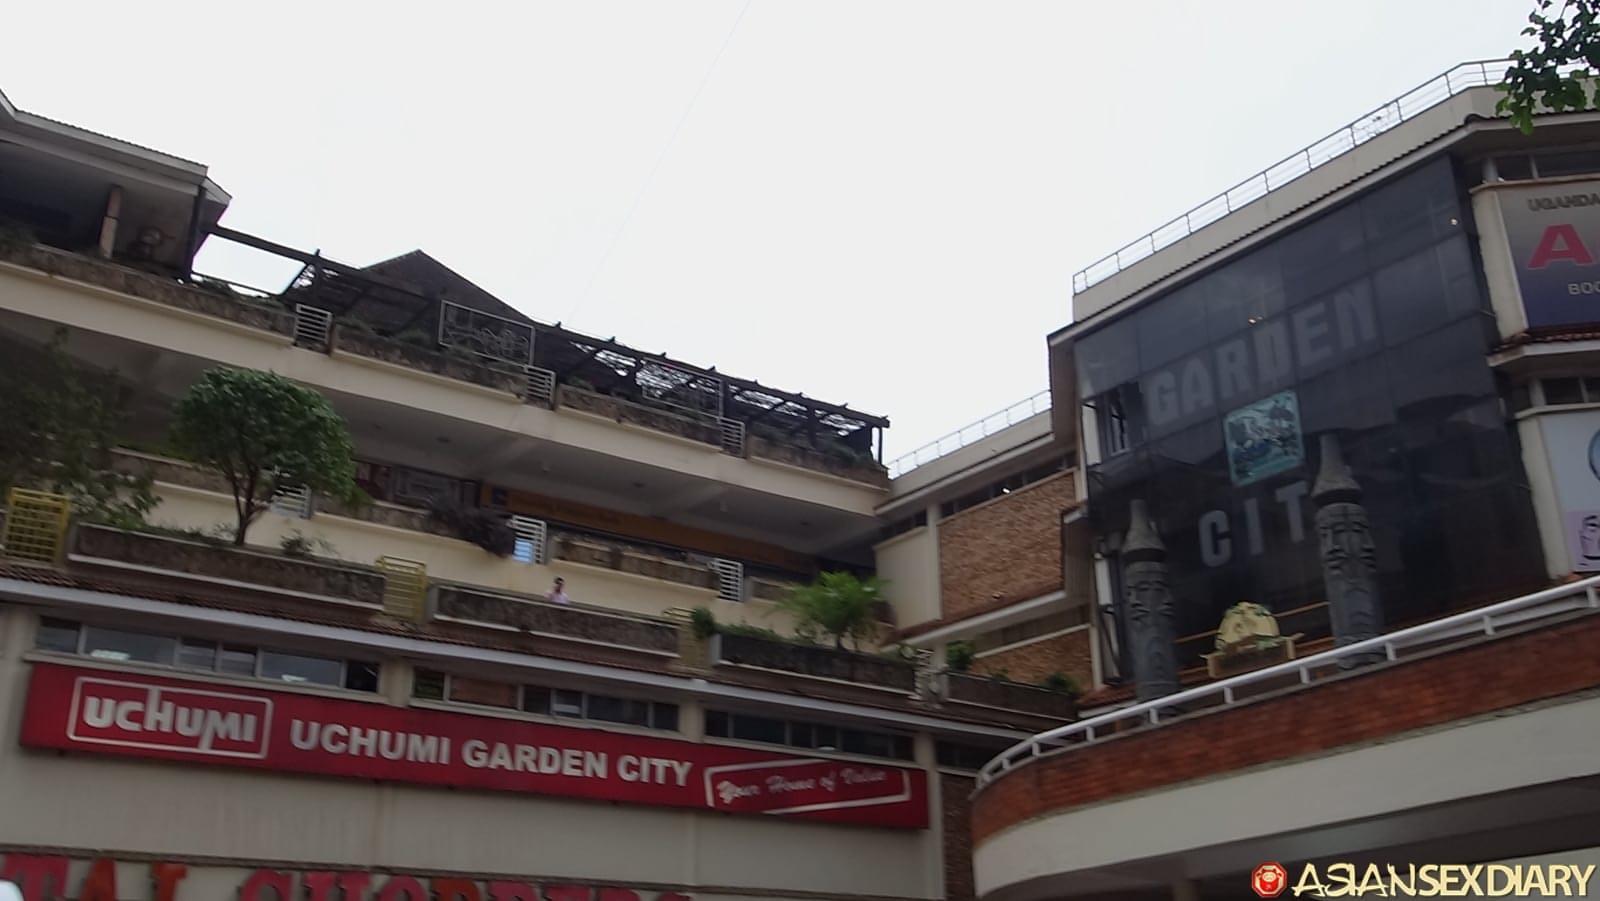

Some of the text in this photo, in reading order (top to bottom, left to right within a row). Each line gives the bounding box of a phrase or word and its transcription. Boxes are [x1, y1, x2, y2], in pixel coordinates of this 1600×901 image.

[1527, 223, 1600, 270] A
[1150, 277, 1376, 425] GARDEN
[1199, 480, 1311, 568] CIT
[290, 719, 693, 787] UCHUMI GARDEN CITY
